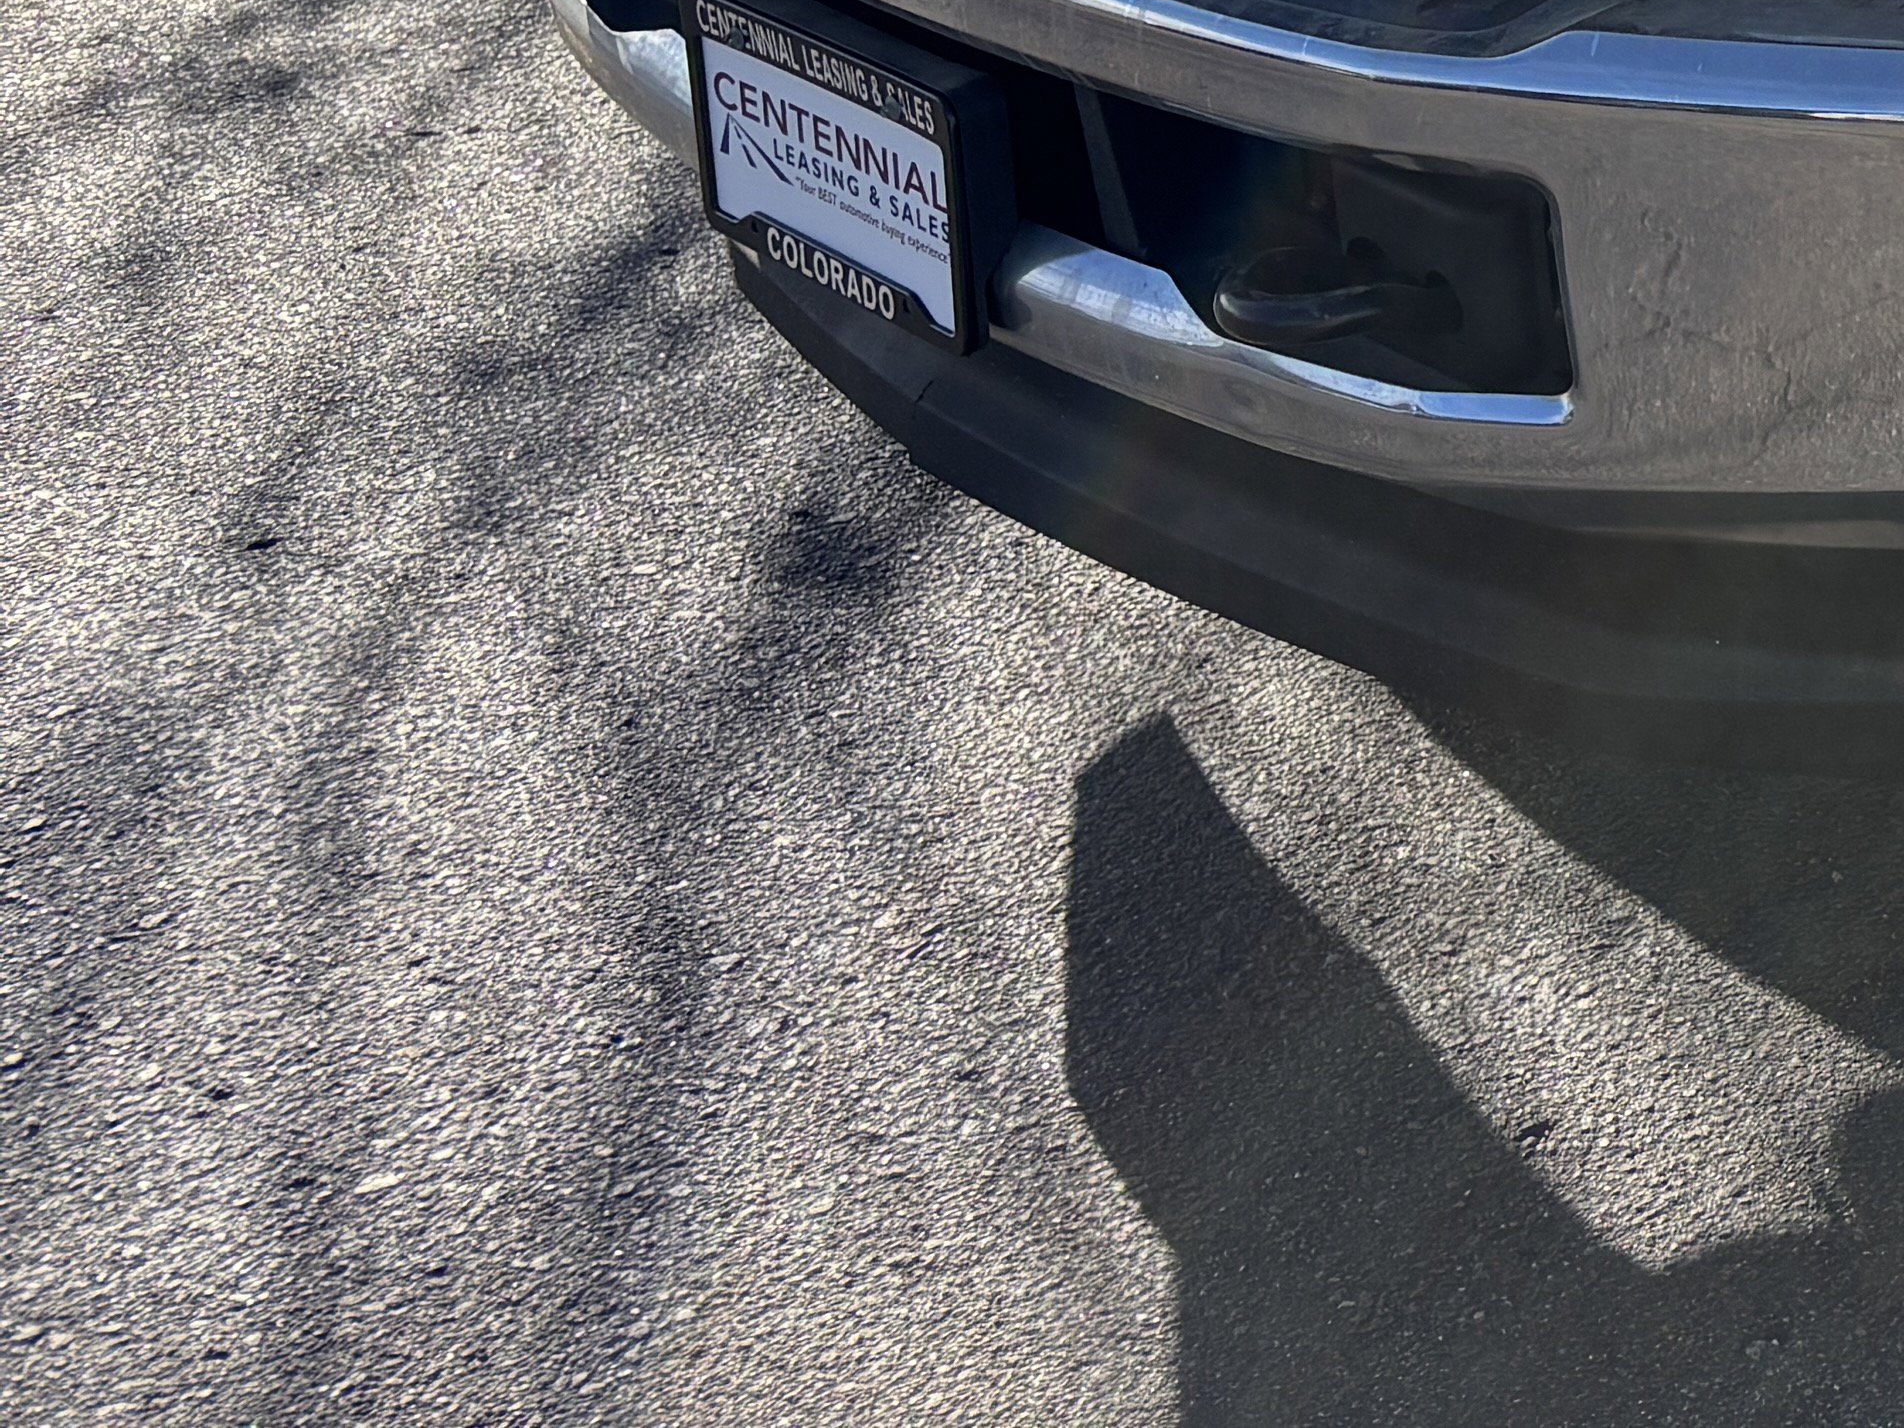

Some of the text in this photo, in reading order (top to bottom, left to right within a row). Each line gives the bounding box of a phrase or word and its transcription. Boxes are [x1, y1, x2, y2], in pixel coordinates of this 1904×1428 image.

[801, 43, 869, 102] LEASING
[870, 74, 884, 108] &
[713, 71, 949, 214] CENTENNIAL
[772, 137, 950, 244] LEASING & SALES
[766, 227, 896, 321] COLORADO
